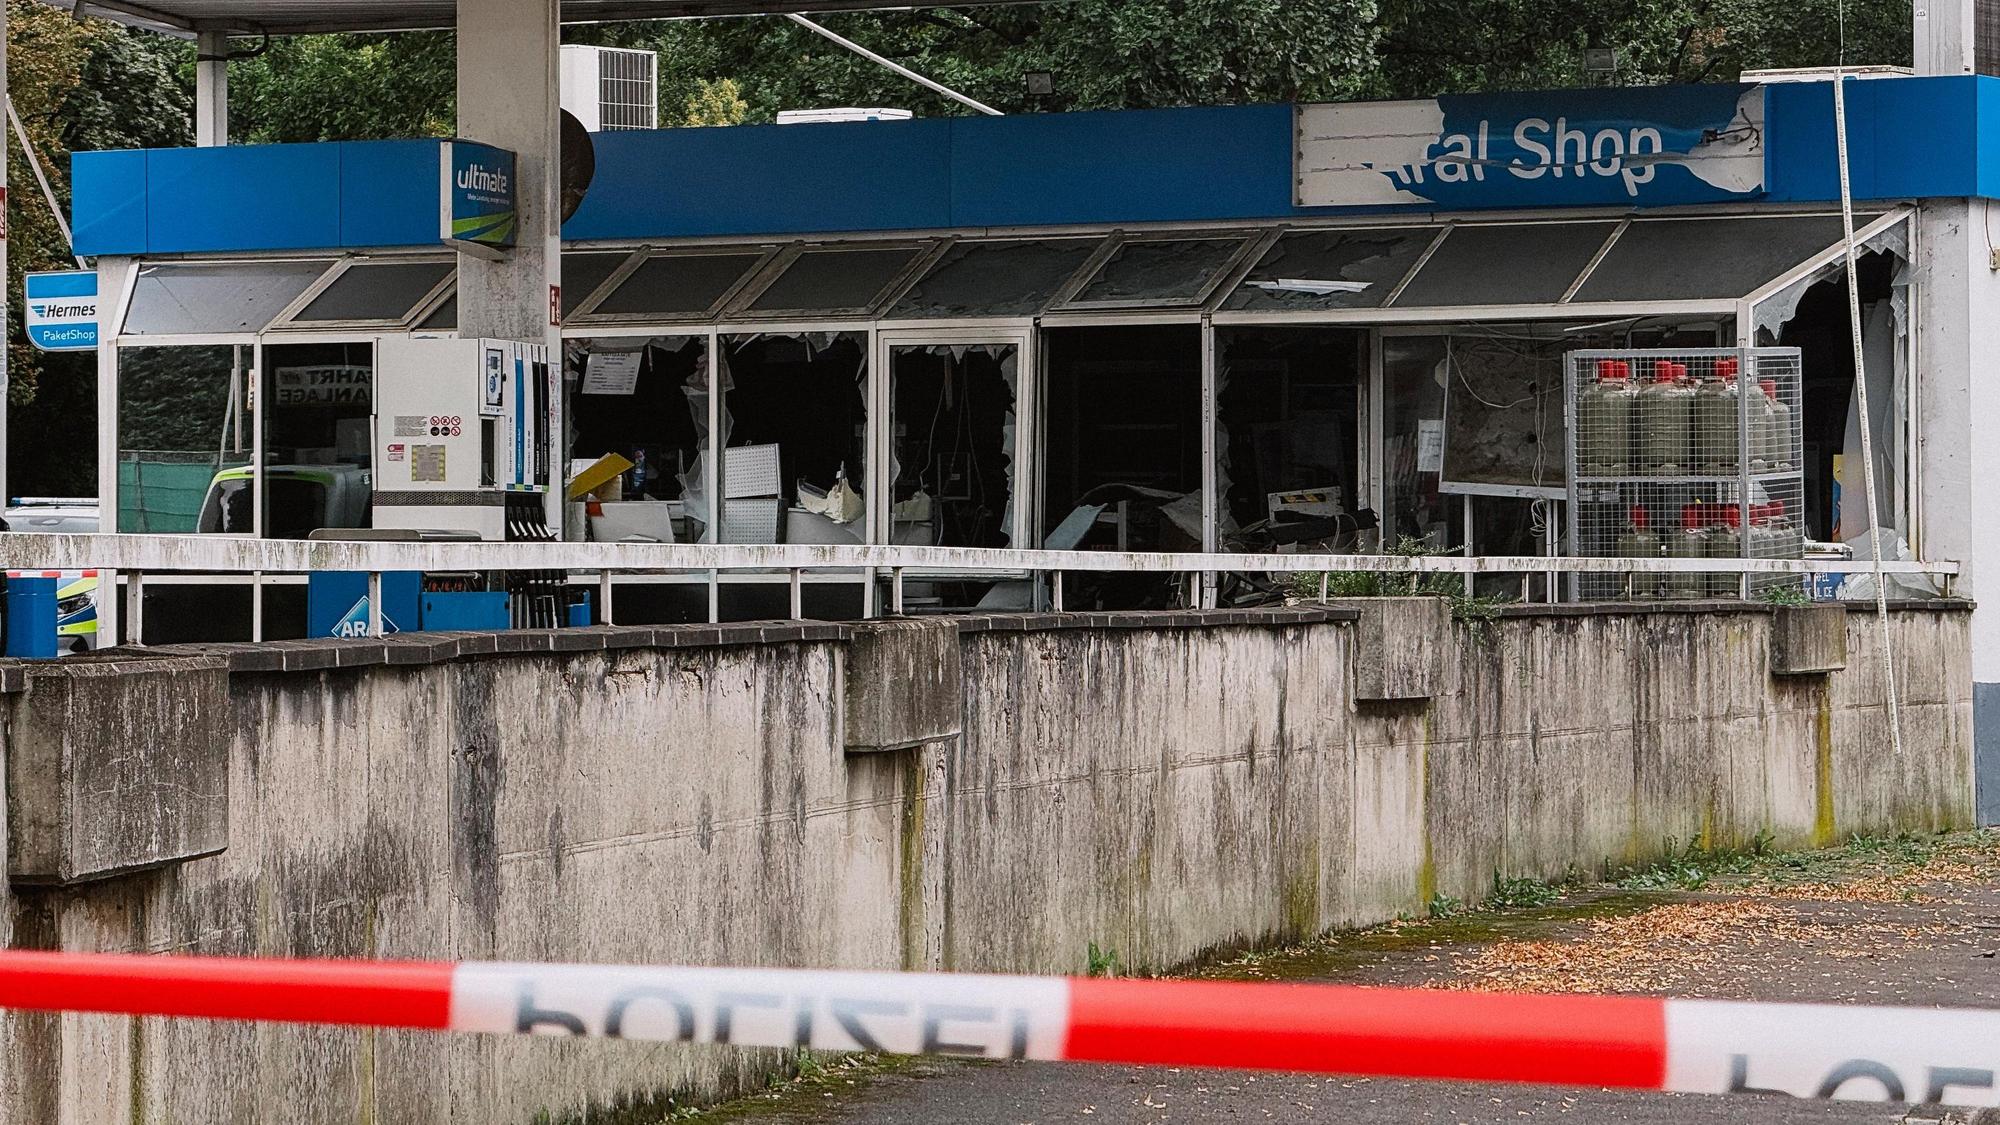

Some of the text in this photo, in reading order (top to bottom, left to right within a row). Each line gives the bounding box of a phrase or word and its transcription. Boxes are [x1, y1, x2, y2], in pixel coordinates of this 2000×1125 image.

[1395, 116, 1663, 197] ral Shop
[457, 163, 507, 194] ultimate
[46, 304, 96, 318] Hermes
[43, 329, 96, 342] PaketShop
[340, 620, 389, 638] ARL
